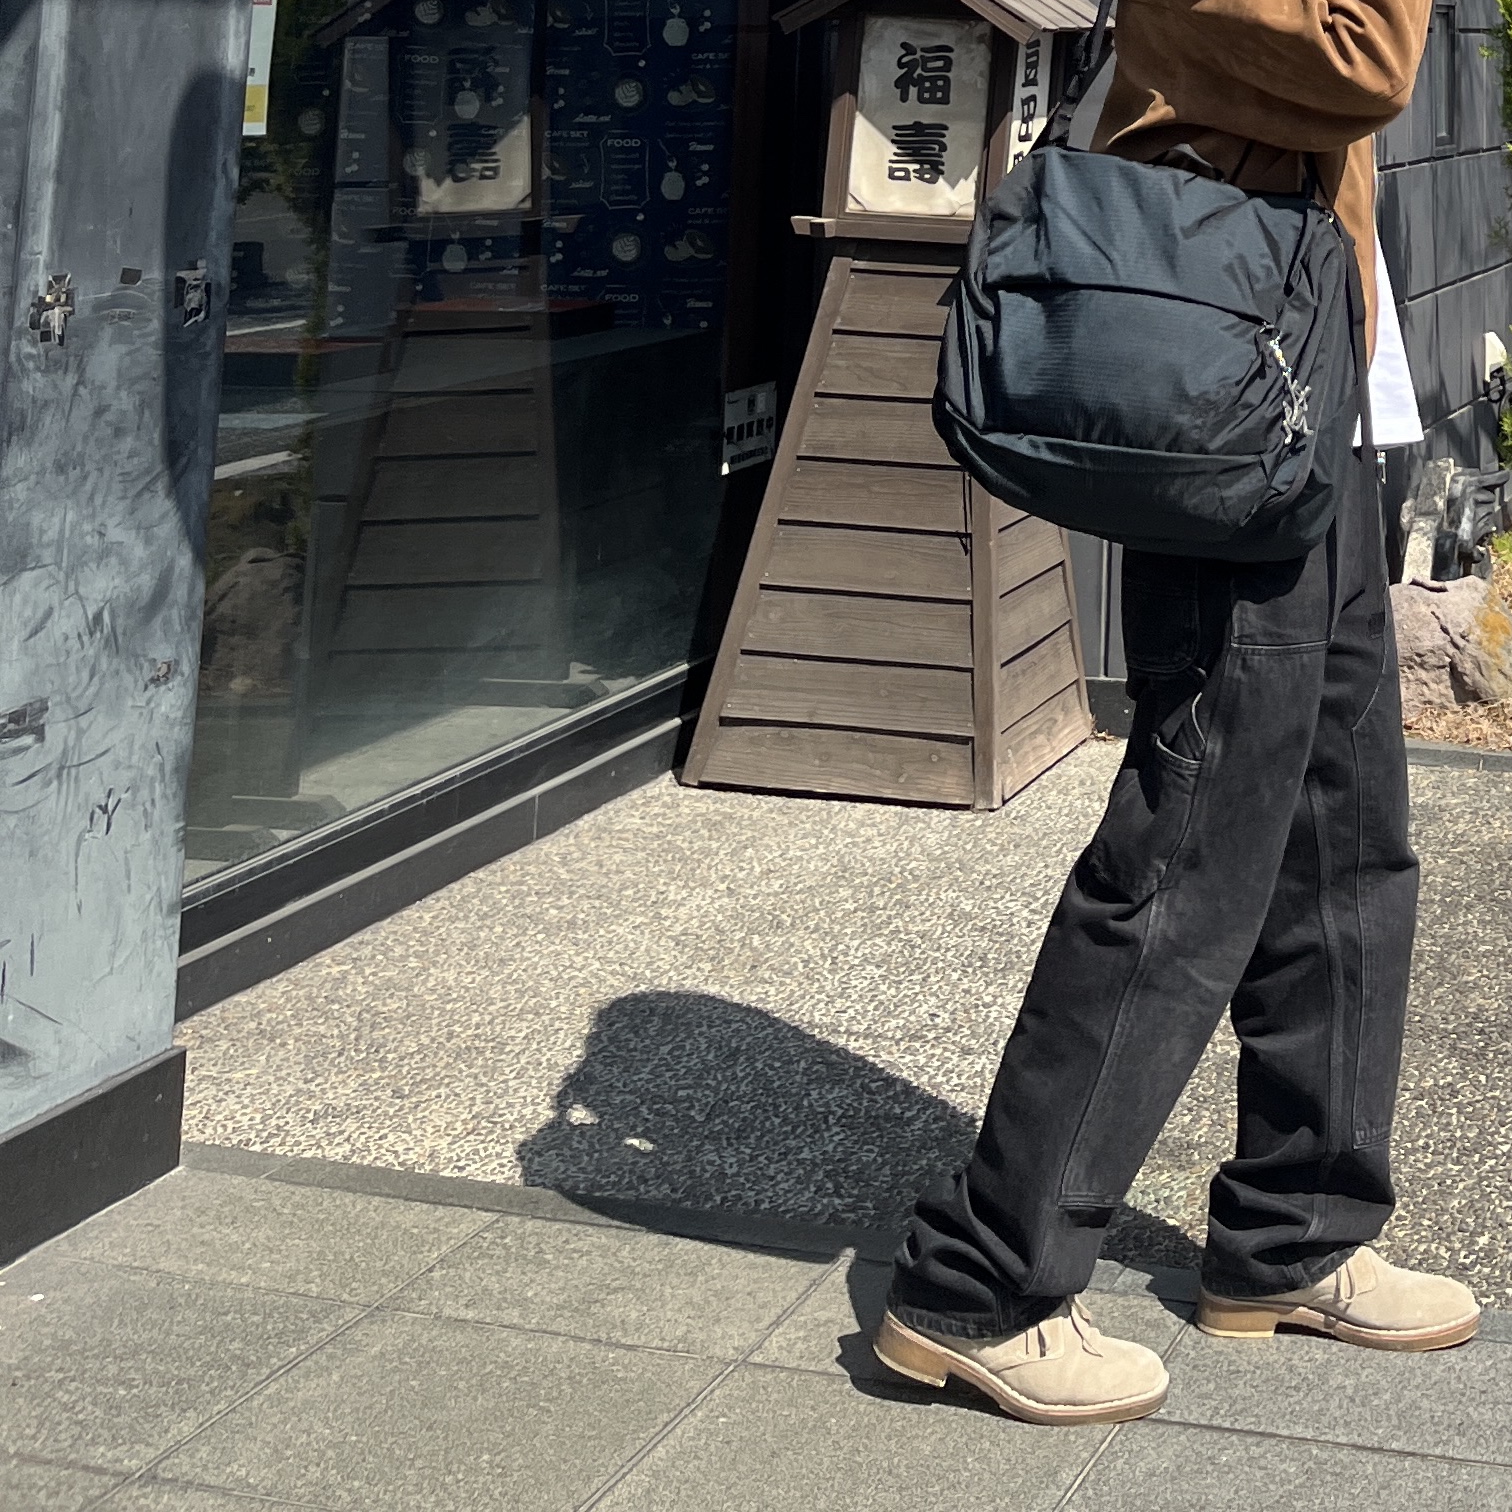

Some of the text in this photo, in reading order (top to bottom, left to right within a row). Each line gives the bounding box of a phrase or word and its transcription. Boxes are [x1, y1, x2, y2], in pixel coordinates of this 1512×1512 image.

[404, 55, 440, 64] FOOD
[606, 138, 641, 147] FOOD
[604, 294, 640, 302] FOOD
